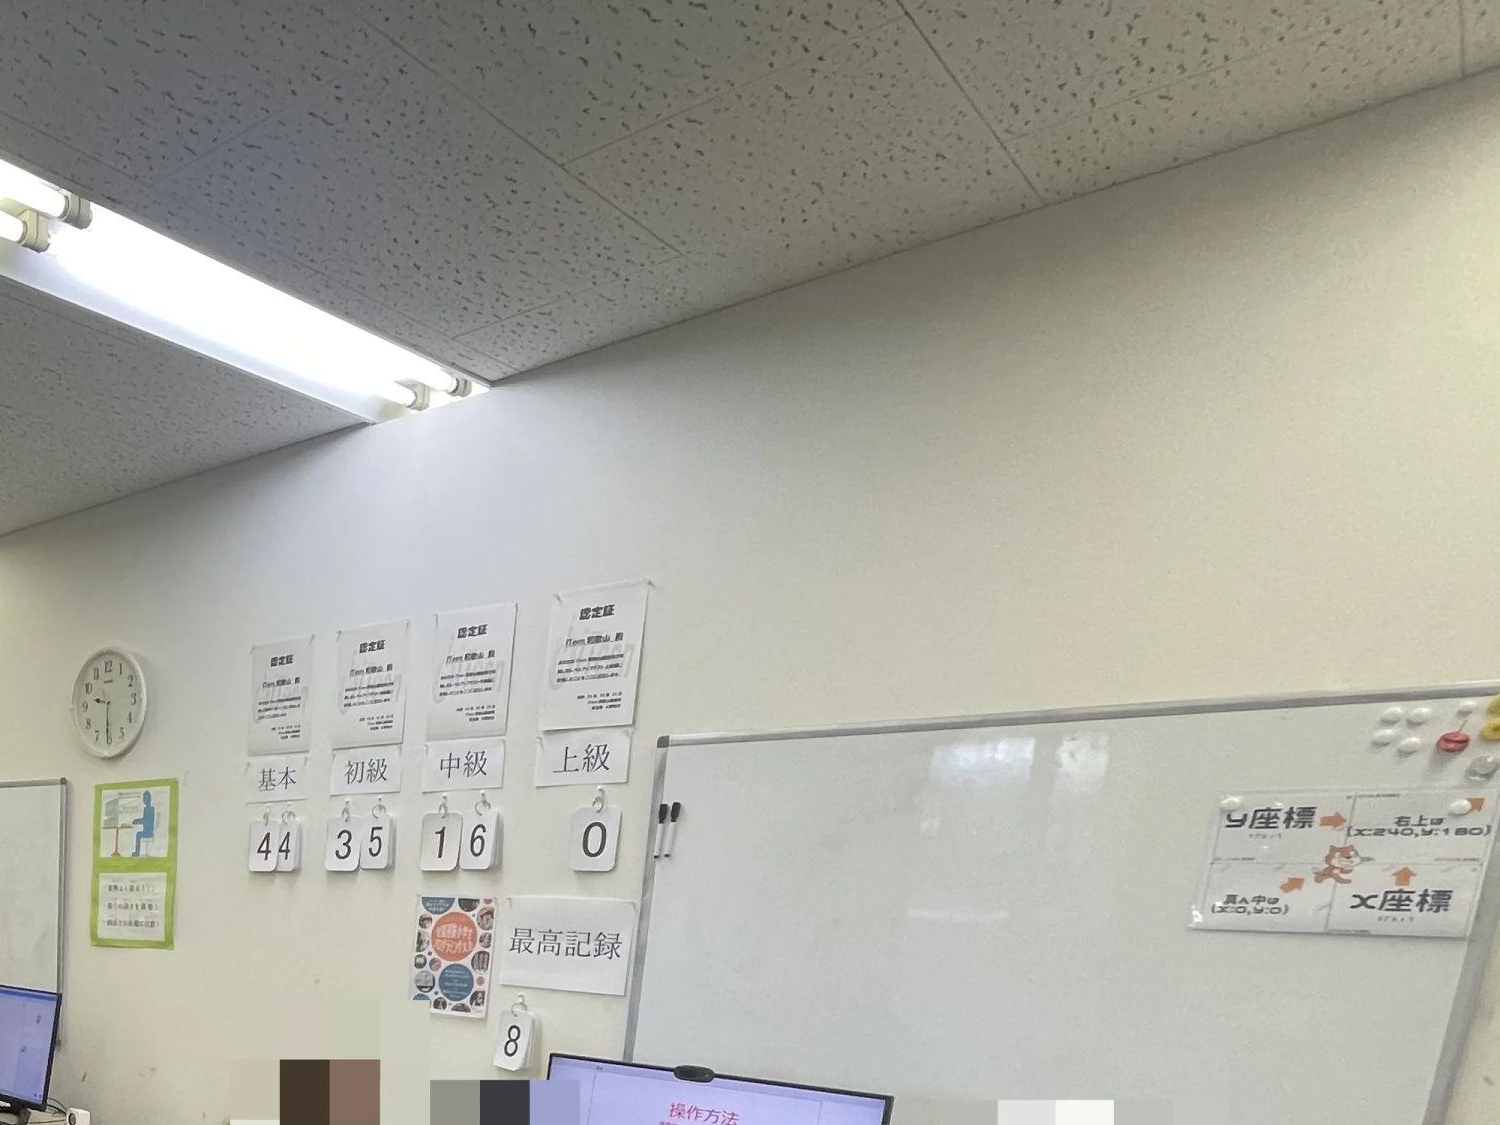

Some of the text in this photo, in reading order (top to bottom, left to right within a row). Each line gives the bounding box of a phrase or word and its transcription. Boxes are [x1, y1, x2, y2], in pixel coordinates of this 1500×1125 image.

[93, 667, 100, 680] 11
[104, 660, 113, 673] 12
[118, 663, 123, 675] 1
[127, 674, 134, 688] 2
[85, 682, 93, 695] 10
[131, 692, 137, 706] 3
[82, 700, 88, 713] 9
[86, 718, 92, 730] 8
[94, 730, 100, 742] 7
[118, 726, 125, 740] 5
[439, 750, 488, 779] 中級
[552, 743, 611, 774] 上級
[344, 758, 388, 785] 初級
[258, 766, 298, 792] 基本
[1225, 806, 1318, 830] y座標
[582, 821, 608, 858] 0
[1349, 888, 1454, 913] x座標
[509, 927, 622, 960] 最高記録
[504, 1025, 521, 1057] 8
